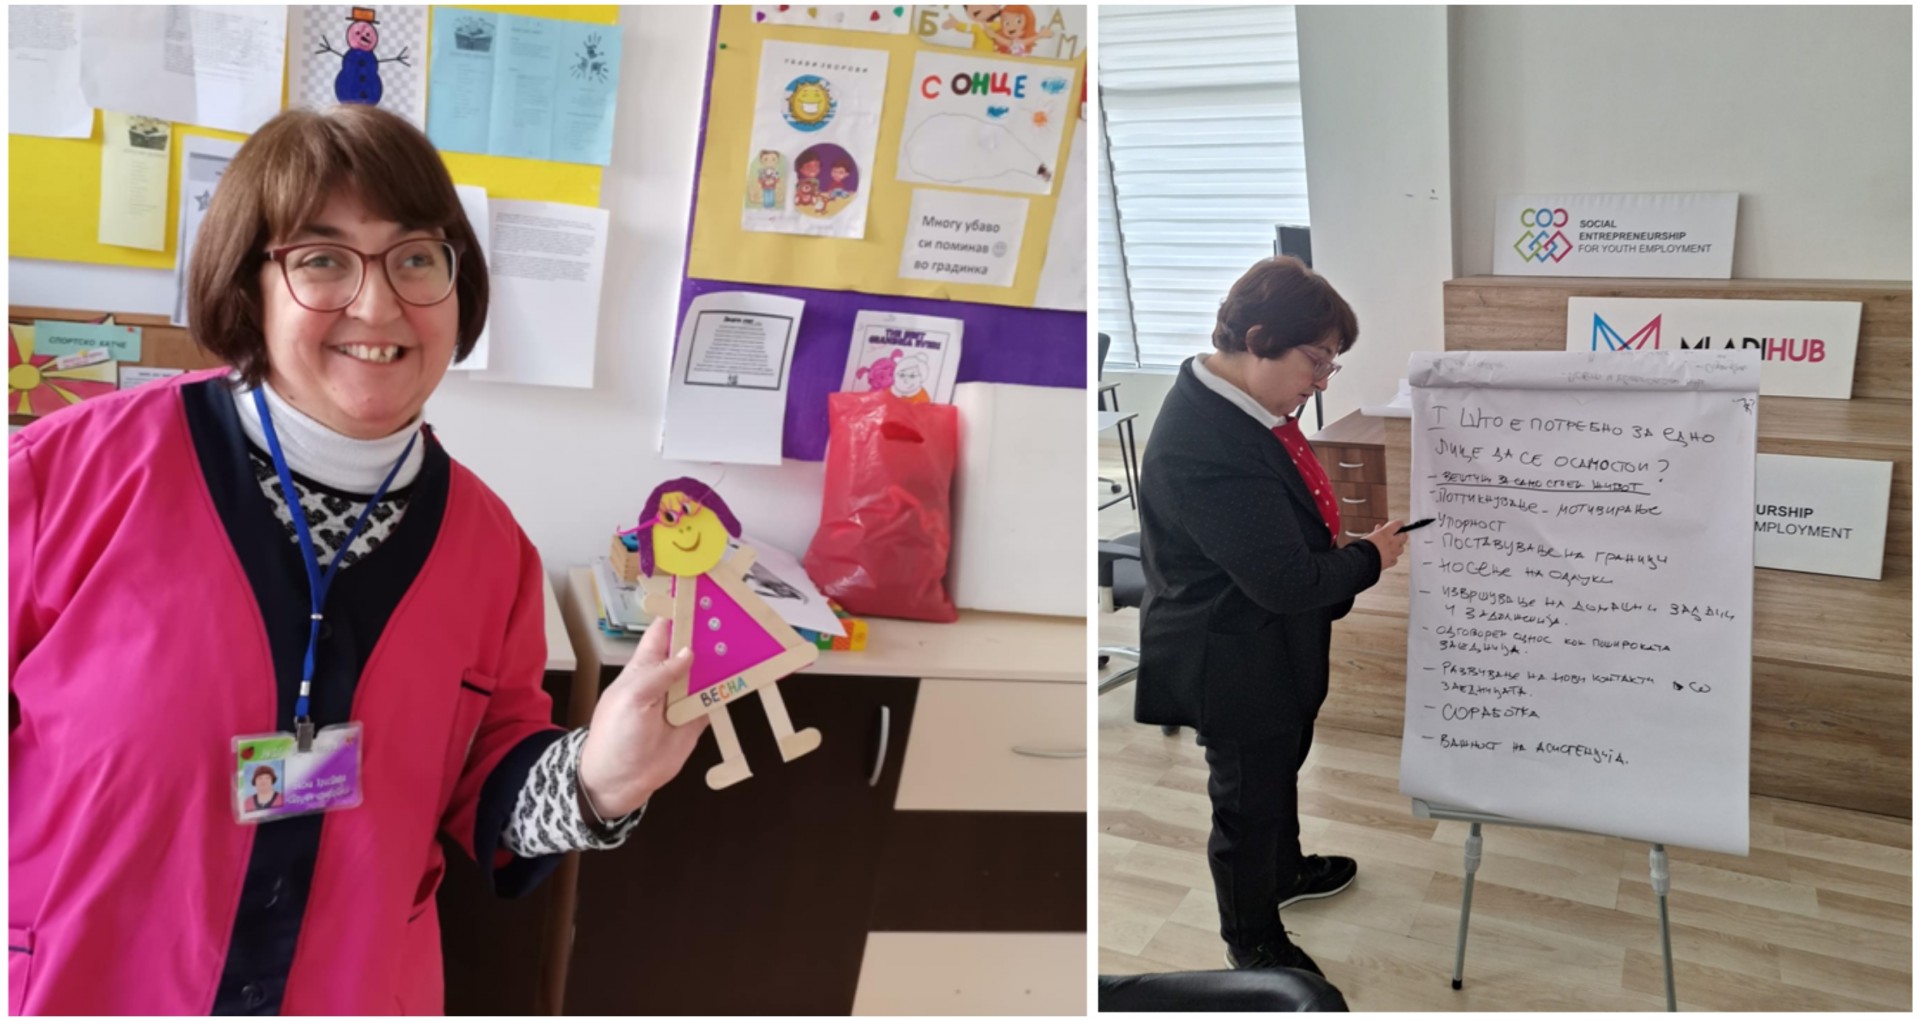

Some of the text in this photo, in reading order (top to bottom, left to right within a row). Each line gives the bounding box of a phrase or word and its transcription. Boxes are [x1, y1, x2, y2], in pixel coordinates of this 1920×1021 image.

[917, 10, 940, 37] Б
[922, 215, 1001, 234] Многу убаво
[1579, 219, 1618, 229] SOCIAL
[1579, 231, 1687, 242] ENTREPRENEURSHIP
[918, 239, 989, 254] си поминав
[1578, 243, 1713, 254] FOR YOUTH EMPLOYMENT
[914, 260, 988, 276] во градинка
[1756, 504, 1814, 519] URSHIP
[1754, 520, 1854, 540] MPLOYMENT
[700, 676, 748, 708] ВЕСНА
